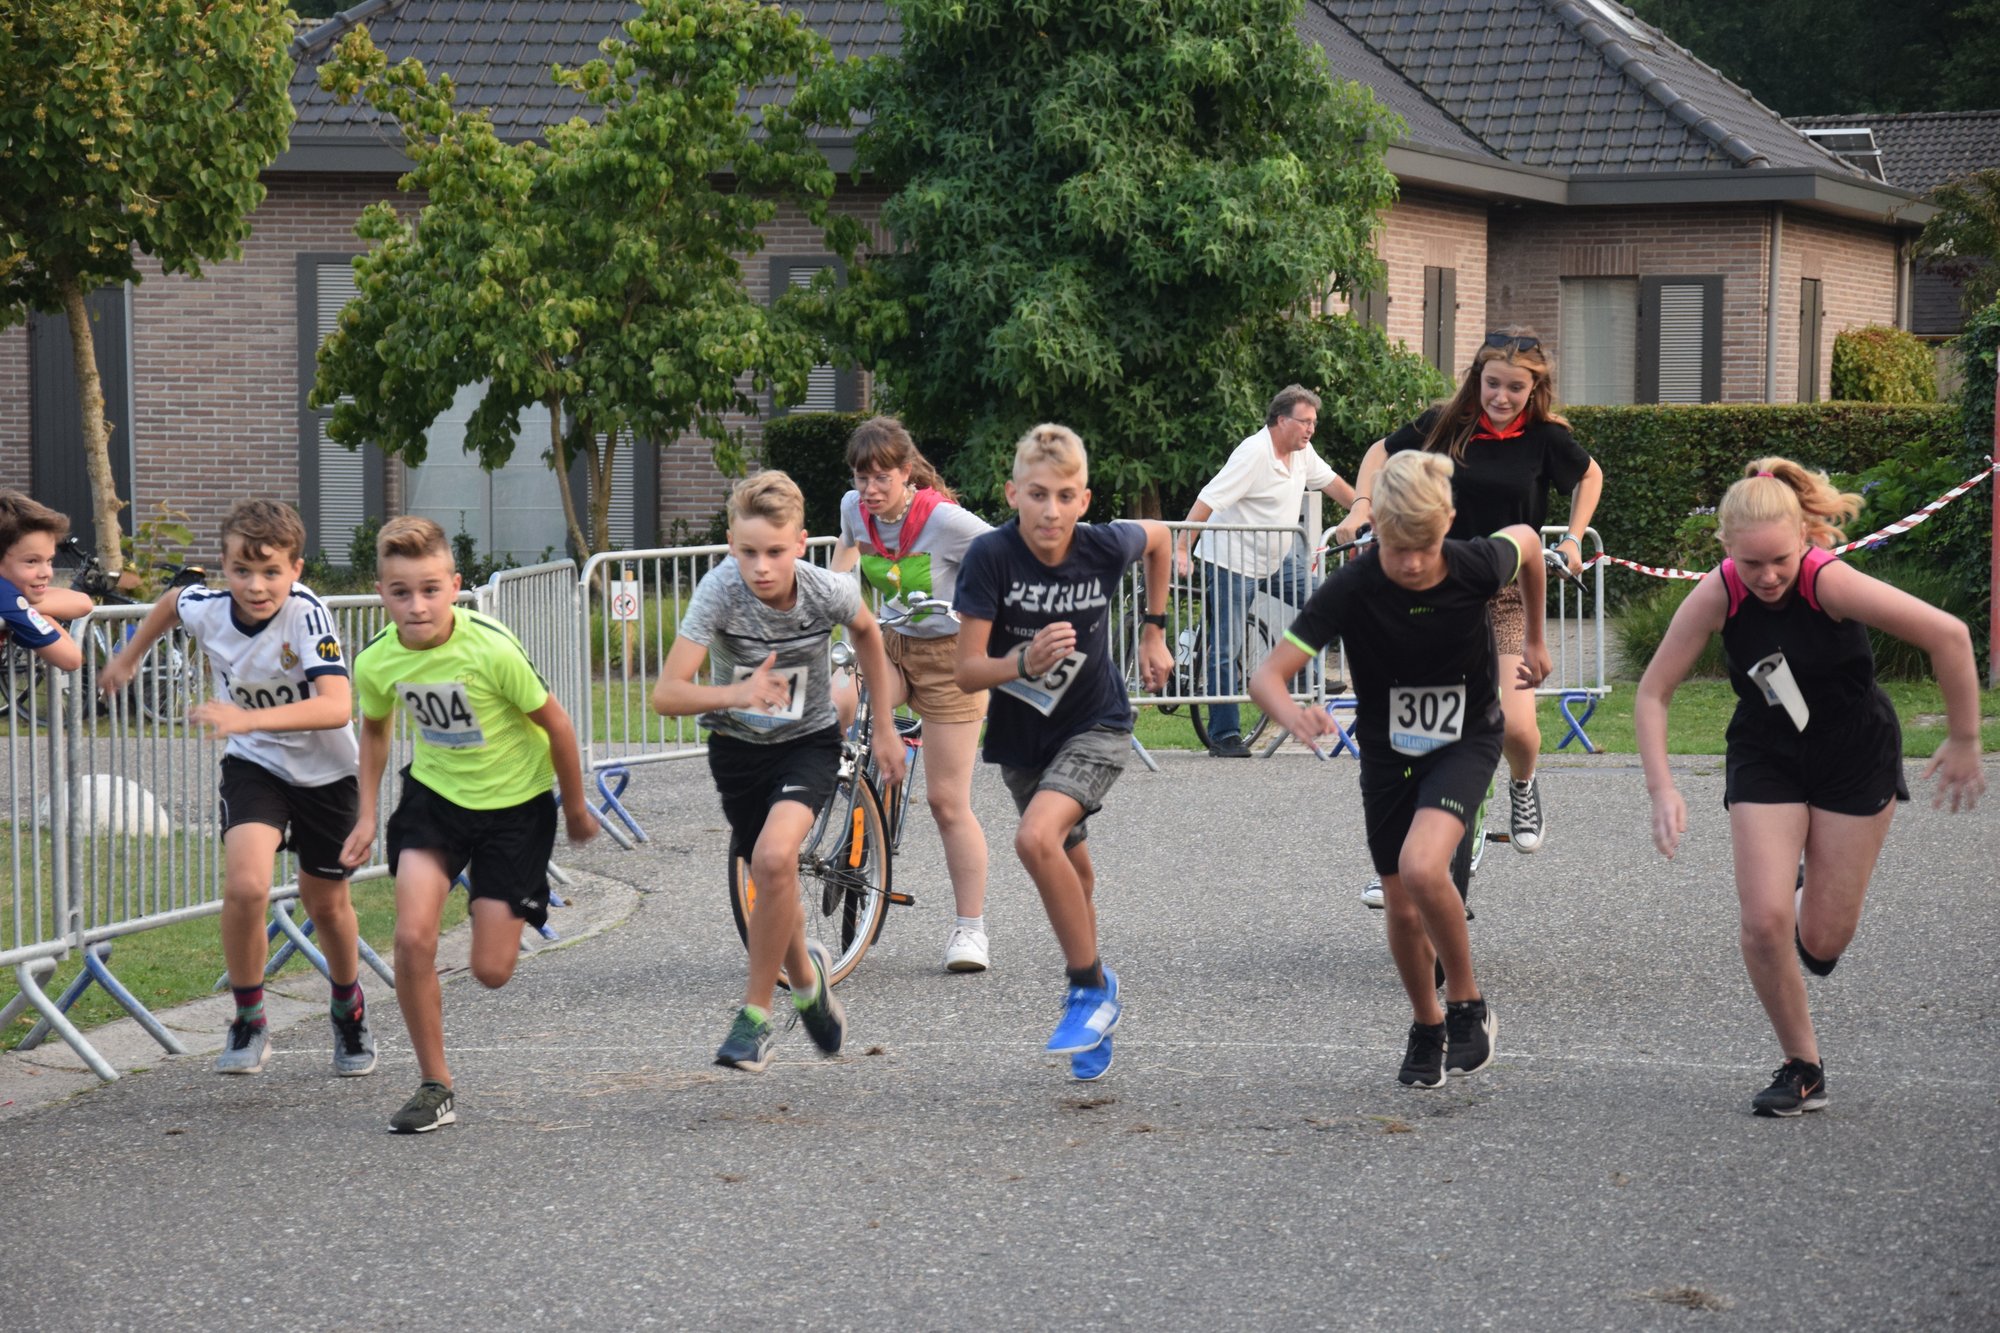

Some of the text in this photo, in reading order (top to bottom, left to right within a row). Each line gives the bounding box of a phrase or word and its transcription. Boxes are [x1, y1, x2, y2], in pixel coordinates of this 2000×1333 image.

[1004, 577, 1107, 612] PETROL
[406, 690, 472, 729] 304
[1398, 691, 1460, 735] 302
